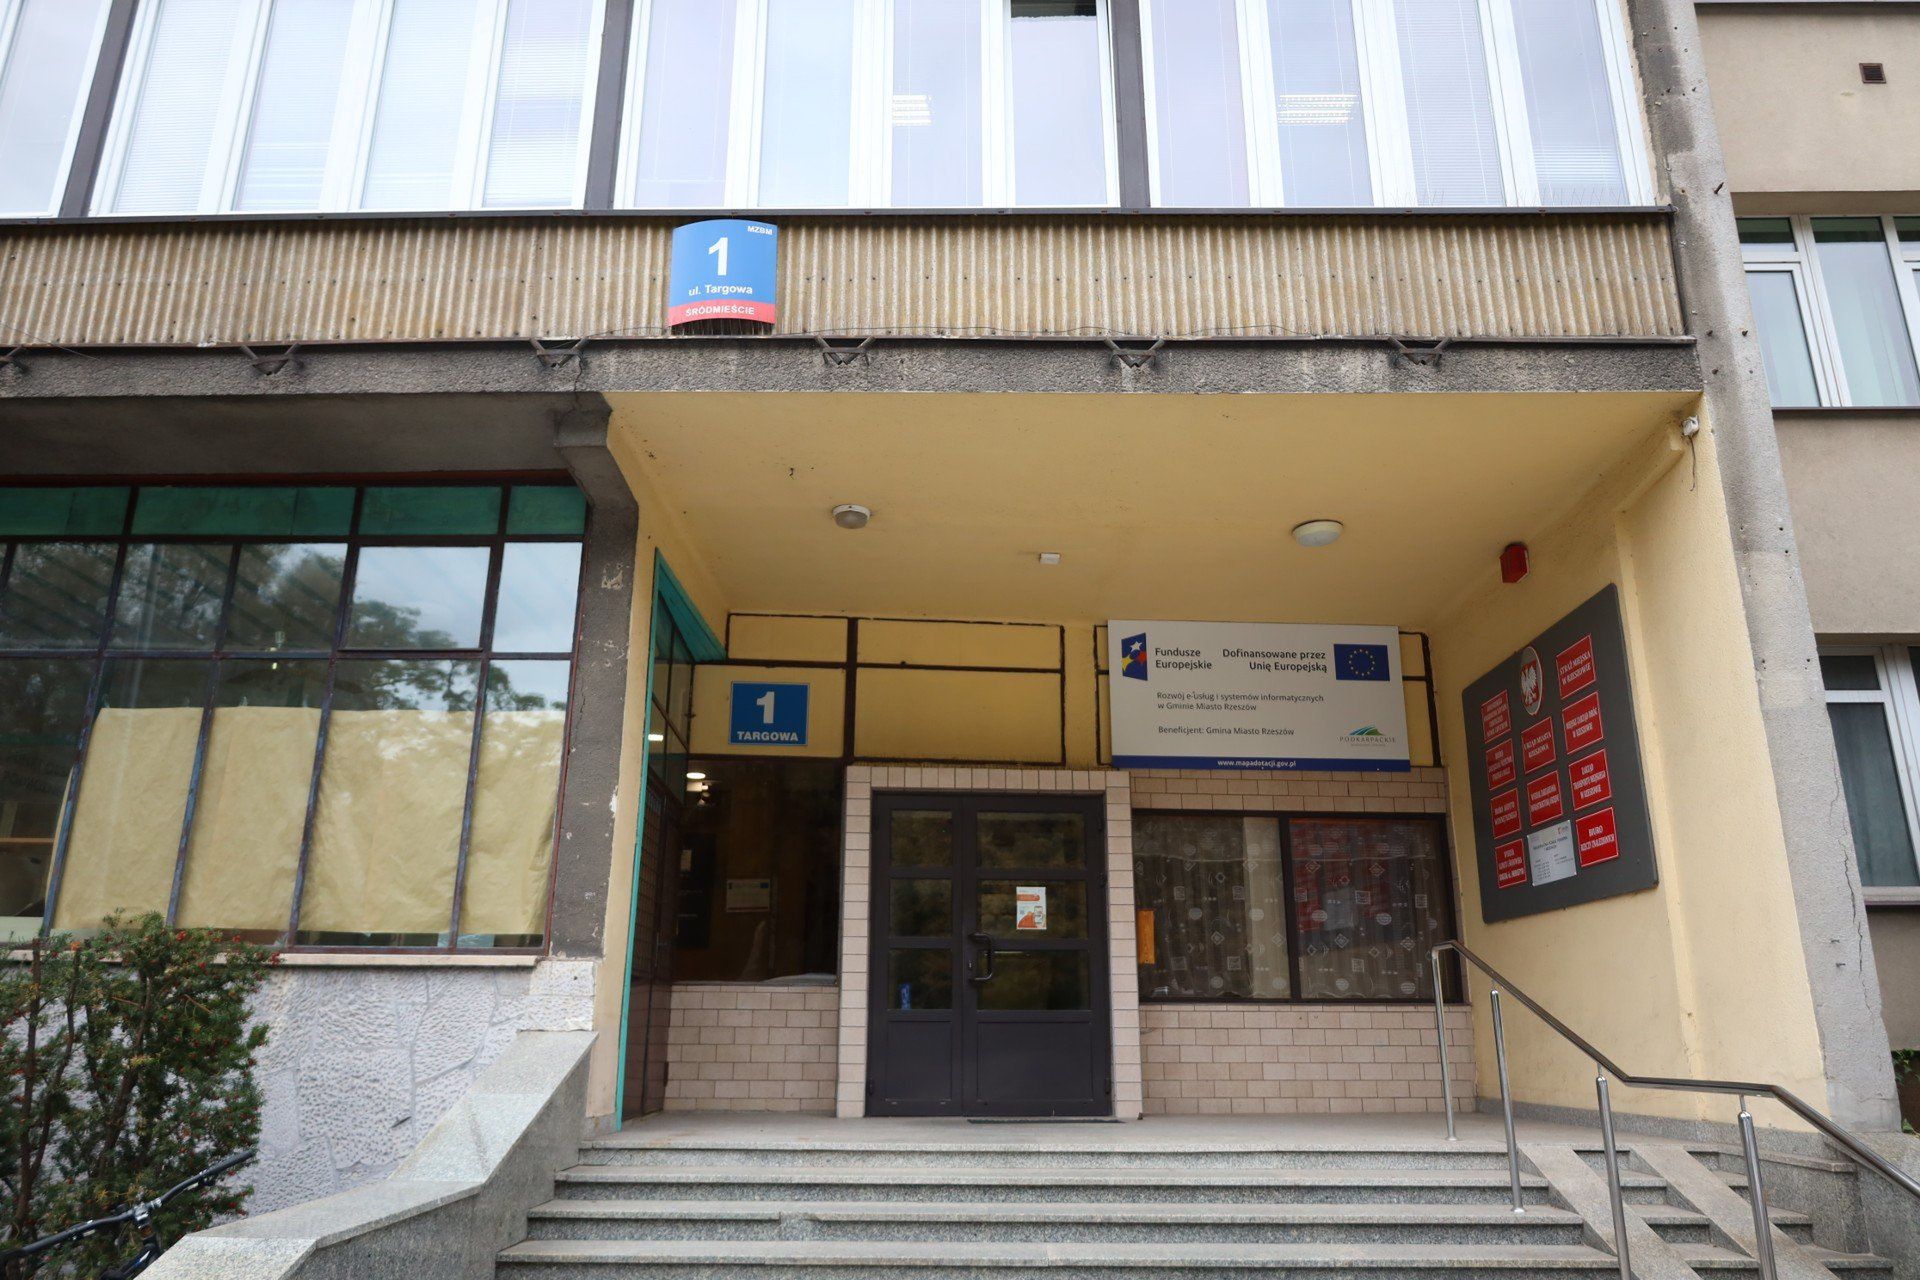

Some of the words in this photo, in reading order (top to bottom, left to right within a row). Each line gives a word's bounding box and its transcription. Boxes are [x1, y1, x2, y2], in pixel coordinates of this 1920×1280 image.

[708, 237, 728, 276] 1
[688, 286, 701, 296] ul.
[705, 284, 753, 295] Targowa
[685, 304, 755, 316] ŚRÓDMIEŚCIE
[1155, 647, 1201, 657] Fundusze
[1222, 648, 1299, 659] Dofinansowane
[1300, 651, 1326, 660] przez
[1155, 660, 1212, 670] Europejskie
[1249, 661, 1271, 672] Unię
[1274, 662, 1328, 673] Europejską
[1157, 692, 1185, 701] Rozwój
[1220, 693, 1260, 702] systemów
[1260, 693, 1324, 703] informatycznych
[757, 691, 775, 724] 1
[1167, 702, 1194, 710] Gminie
[1196, 703, 1222, 711] Miasto
[1224, 703, 1257, 711] Rzeszów
[737, 731, 799, 741] TARGOWA
[1158, 726, 1204, 736] Beneficjent:
[1206, 727, 1232, 735] Gmina
[1233, 727, 1260, 735] Miasto
[1261, 727, 1295, 736] Rzeszów
[1217, 759, 1296, 768] www.mapadotacji.gov.pl
